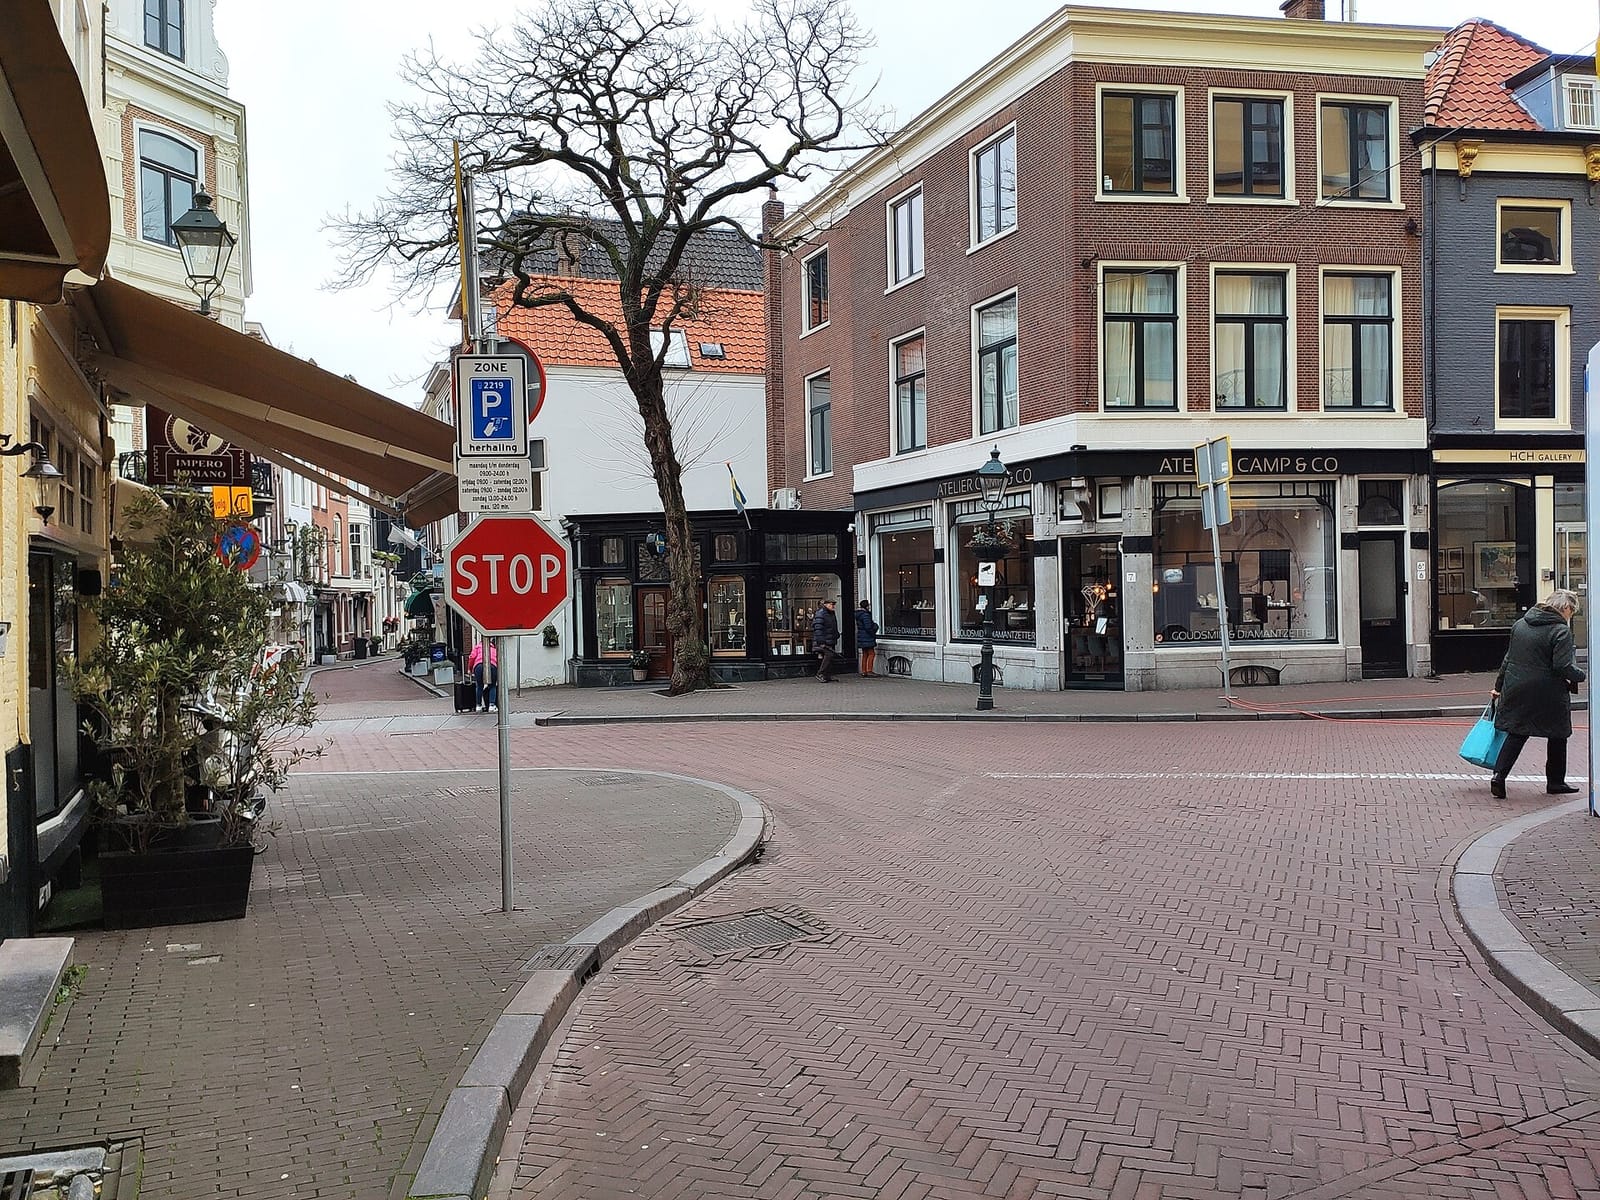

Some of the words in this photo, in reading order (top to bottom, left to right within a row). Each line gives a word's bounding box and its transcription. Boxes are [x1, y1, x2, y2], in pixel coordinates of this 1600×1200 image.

[474, 363, 508, 372] ZONE
[483, 381, 504, 389] 2219
[482, 391, 502, 417] P
[469, 443, 518, 453] herhaling
[1509, 451, 1534, 461] HCH
[1538, 453, 1572, 461] GALLERY
[176, 459, 223, 468] IMPERO
[1237, 457, 1290, 473] CAMP
[1295, 457, 1307, 473] &
[1311, 457, 1338, 473] CO
[937, 479, 973, 497] ATELIER
[1016, 467, 1032, 484] CO
[456, 554, 561, 596] STOP
